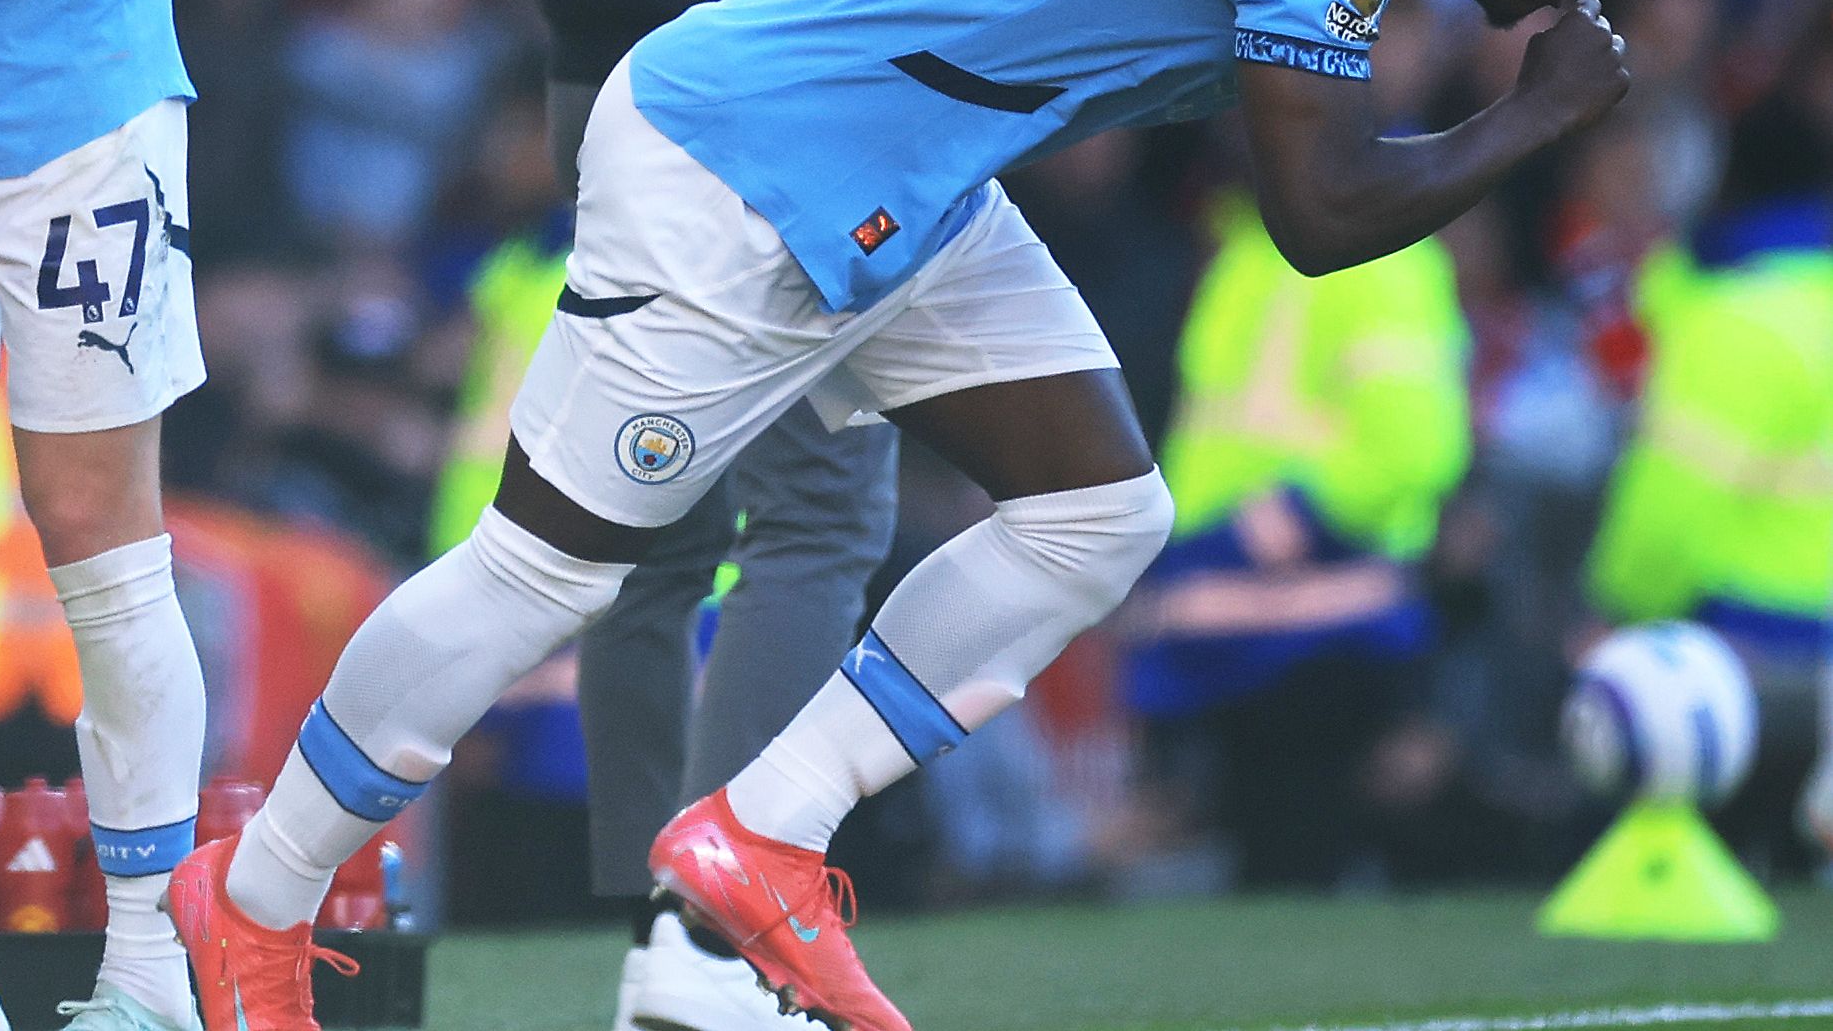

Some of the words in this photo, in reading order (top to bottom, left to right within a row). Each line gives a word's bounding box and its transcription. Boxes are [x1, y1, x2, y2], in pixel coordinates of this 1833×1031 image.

[1326, 2, 1350, 24] No
[37, 198, 149, 324] 47
[632, 418, 689, 449] MANCHESTER
[632, 468, 655, 480] CITY
